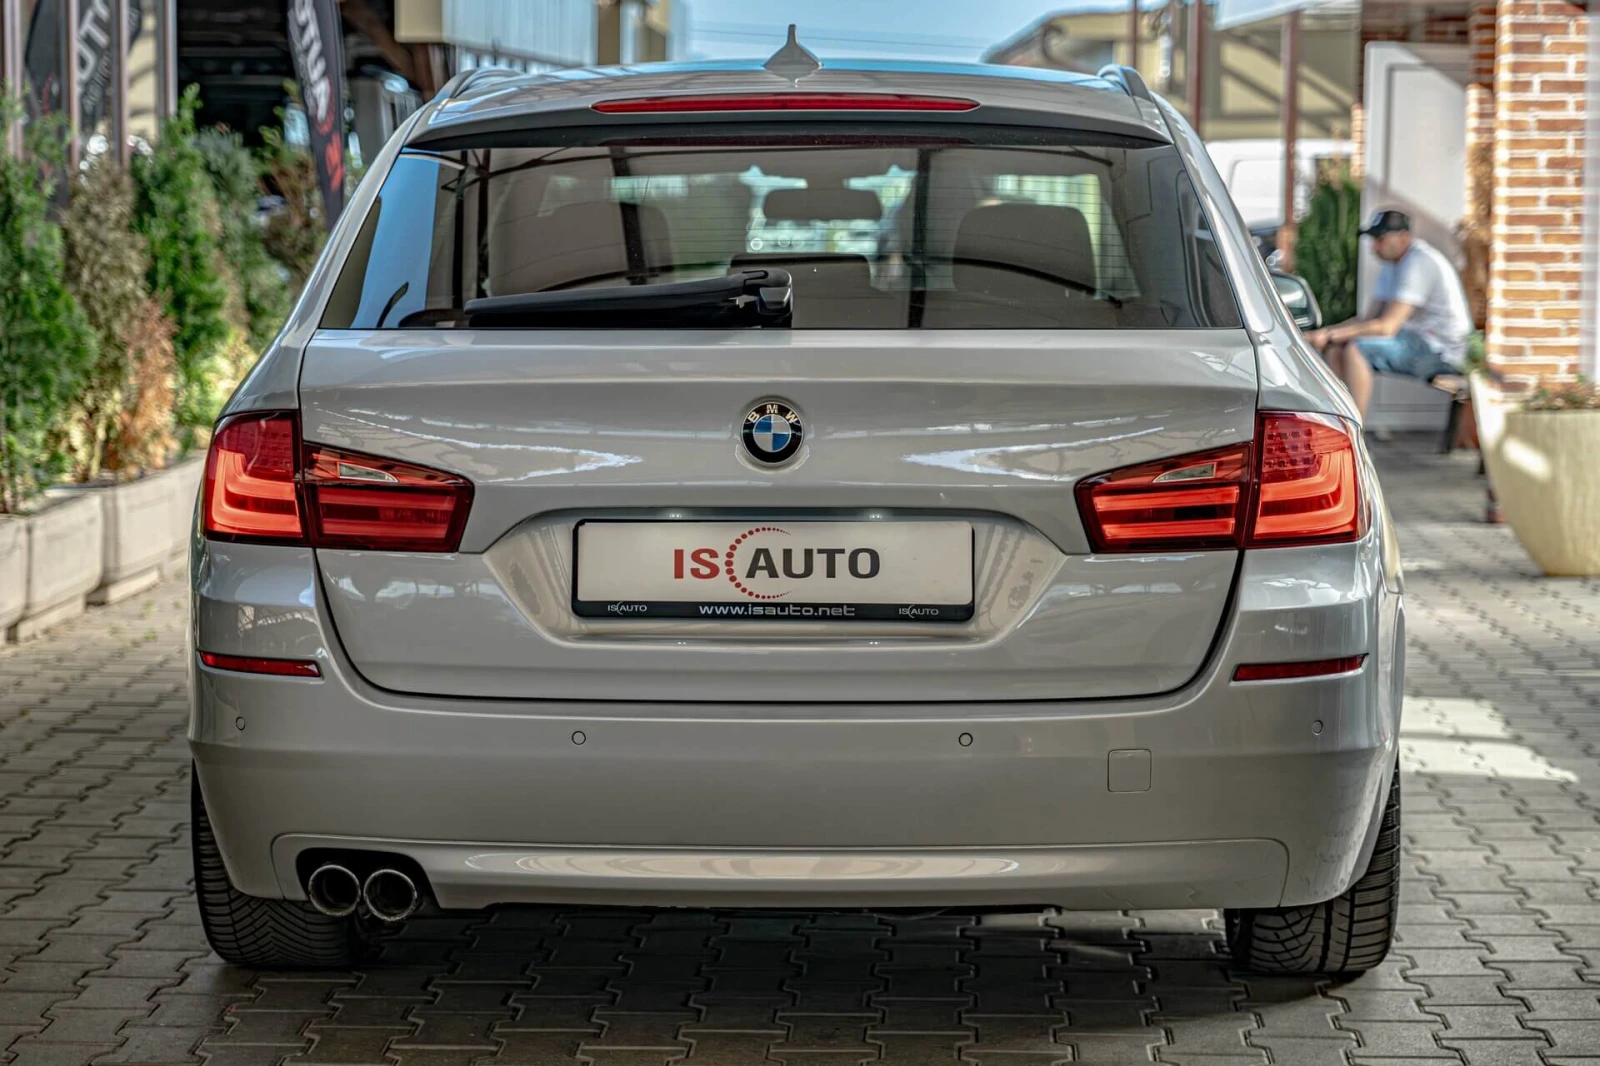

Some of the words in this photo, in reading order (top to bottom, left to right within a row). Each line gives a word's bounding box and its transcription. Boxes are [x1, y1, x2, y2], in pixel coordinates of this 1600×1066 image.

[747, 404, 799, 424] BMW
[673, 548, 721, 580] IS
[745, 547, 881, 580] AUTO
[699, 604, 856, 616] www.isauto.net
